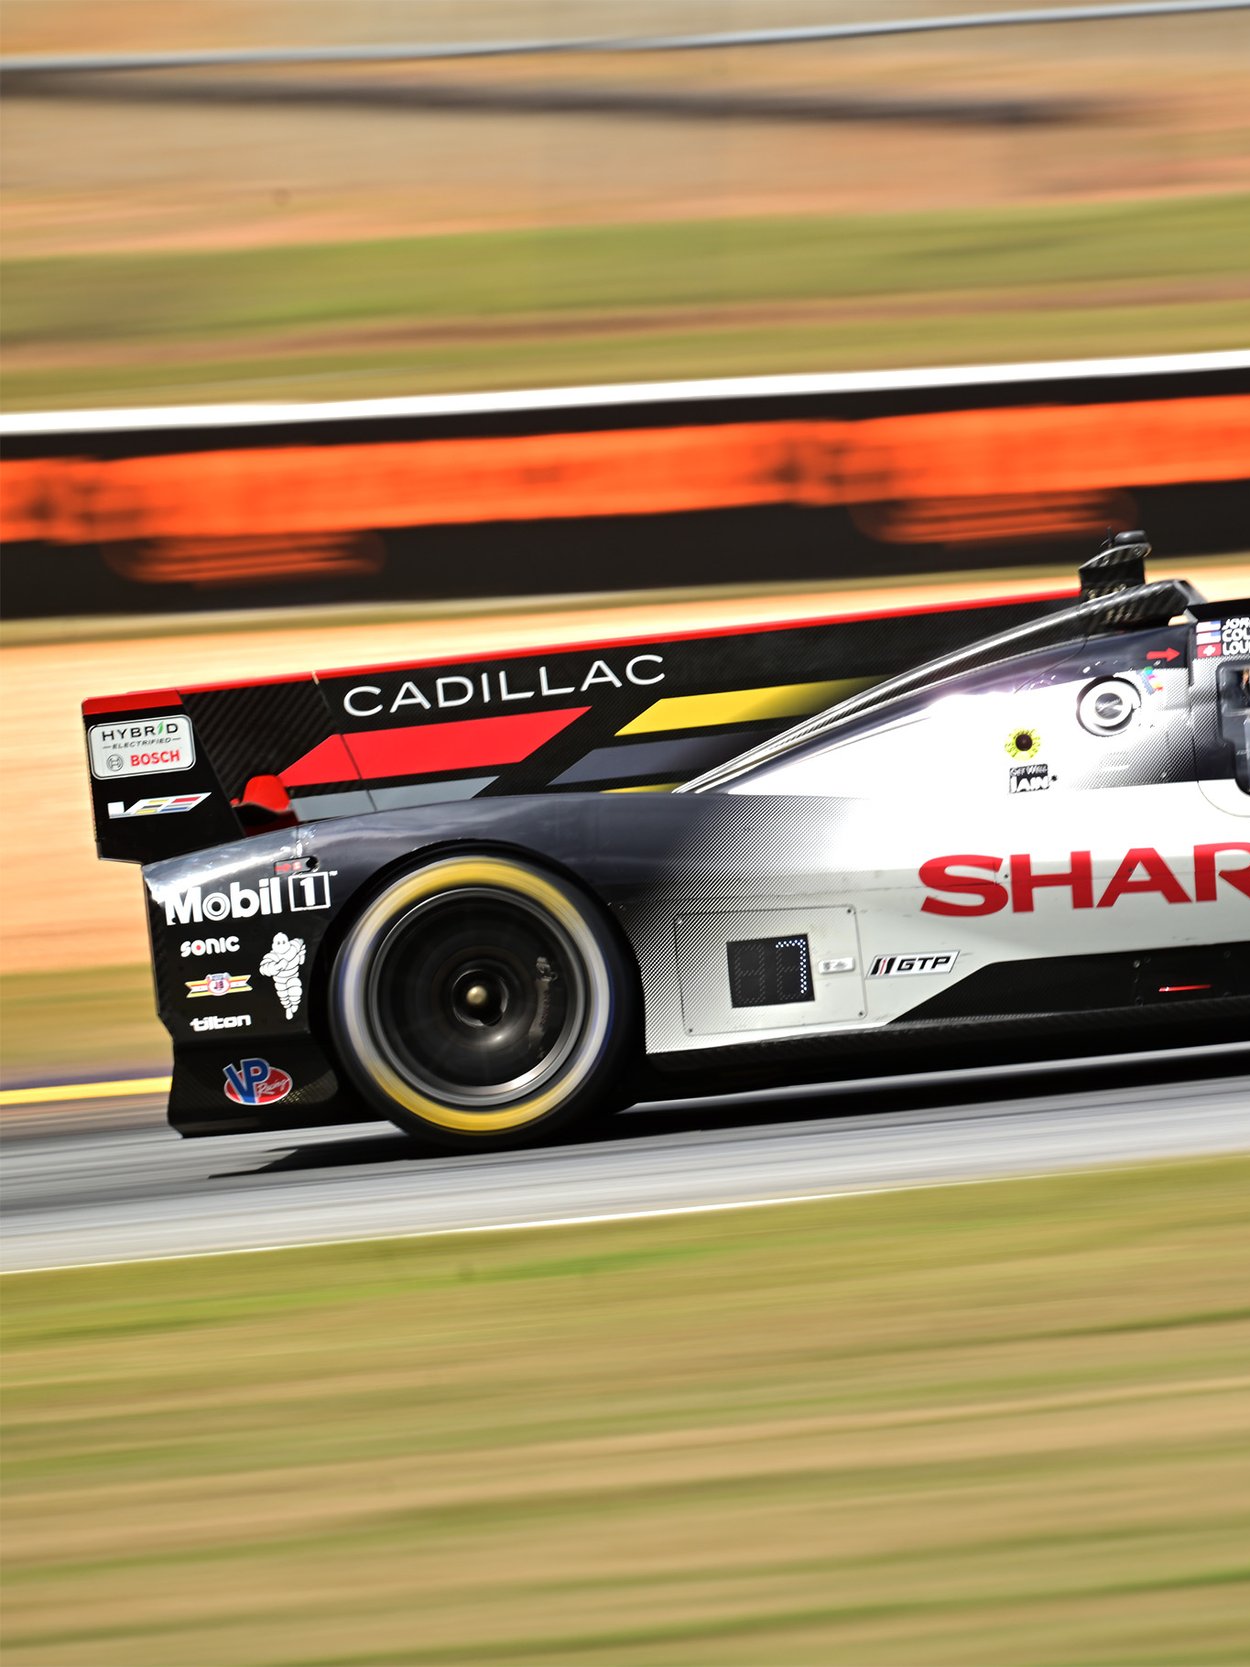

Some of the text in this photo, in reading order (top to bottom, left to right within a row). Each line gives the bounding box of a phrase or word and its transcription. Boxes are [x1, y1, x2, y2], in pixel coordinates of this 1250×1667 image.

[343, 655, 666, 718] CADILLAC
[102, 721, 179, 742] HYBRID
[112, 738, 172, 750] ELECTRIFIED
[130, 749, 180, 767] BOSCH
[164, 876, 283, 926] Mobil
[896, 956, 951, 972] GTP
[189, 1014, 252, 1032] tilton
[222, 1057, 271, 1105] VP
[256, 1079, 290, 1096] Racing
